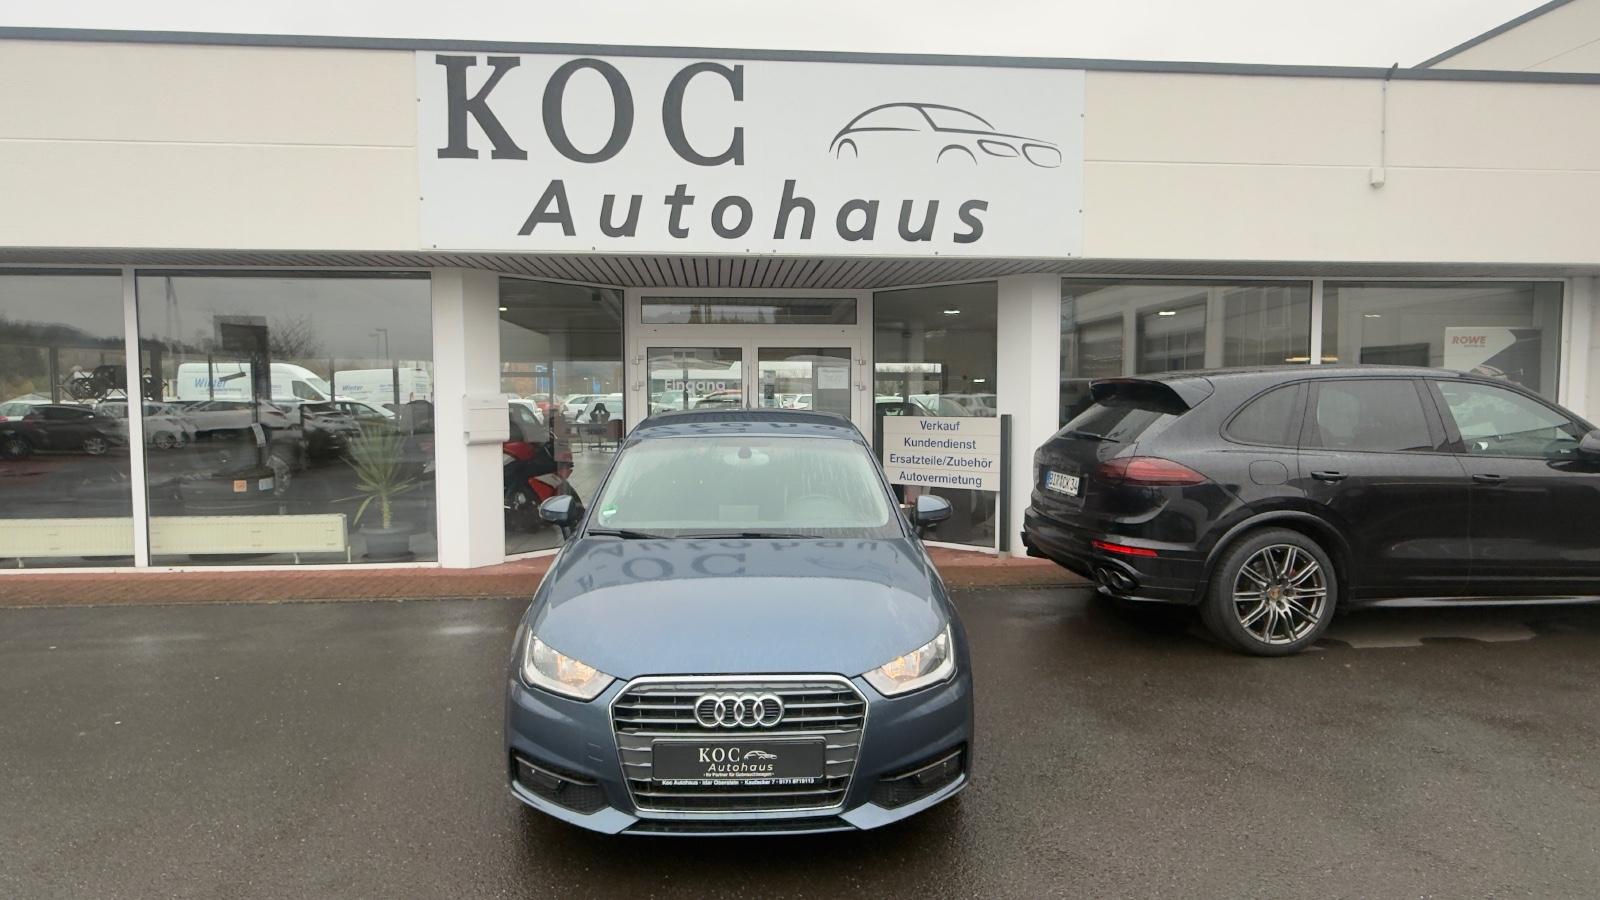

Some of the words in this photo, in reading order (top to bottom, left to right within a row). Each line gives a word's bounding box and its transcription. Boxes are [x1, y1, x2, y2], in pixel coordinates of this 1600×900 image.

[435, 54, 745, 167] KOC
[517, 179, 989, 244] Autohaus
[1452, 335, 1487, 344] ROWE
[920, 420, 960, 431] Verkauf
[904, 437, 977, 450] Kundendienst
[889, 453, 993, 468] Ersatzteile/Zubehör
[899, 471, 982, 488] Autovermietung
[698, 747, 740, 763] KOC
[708, 762, 774, 772] Autohaus
